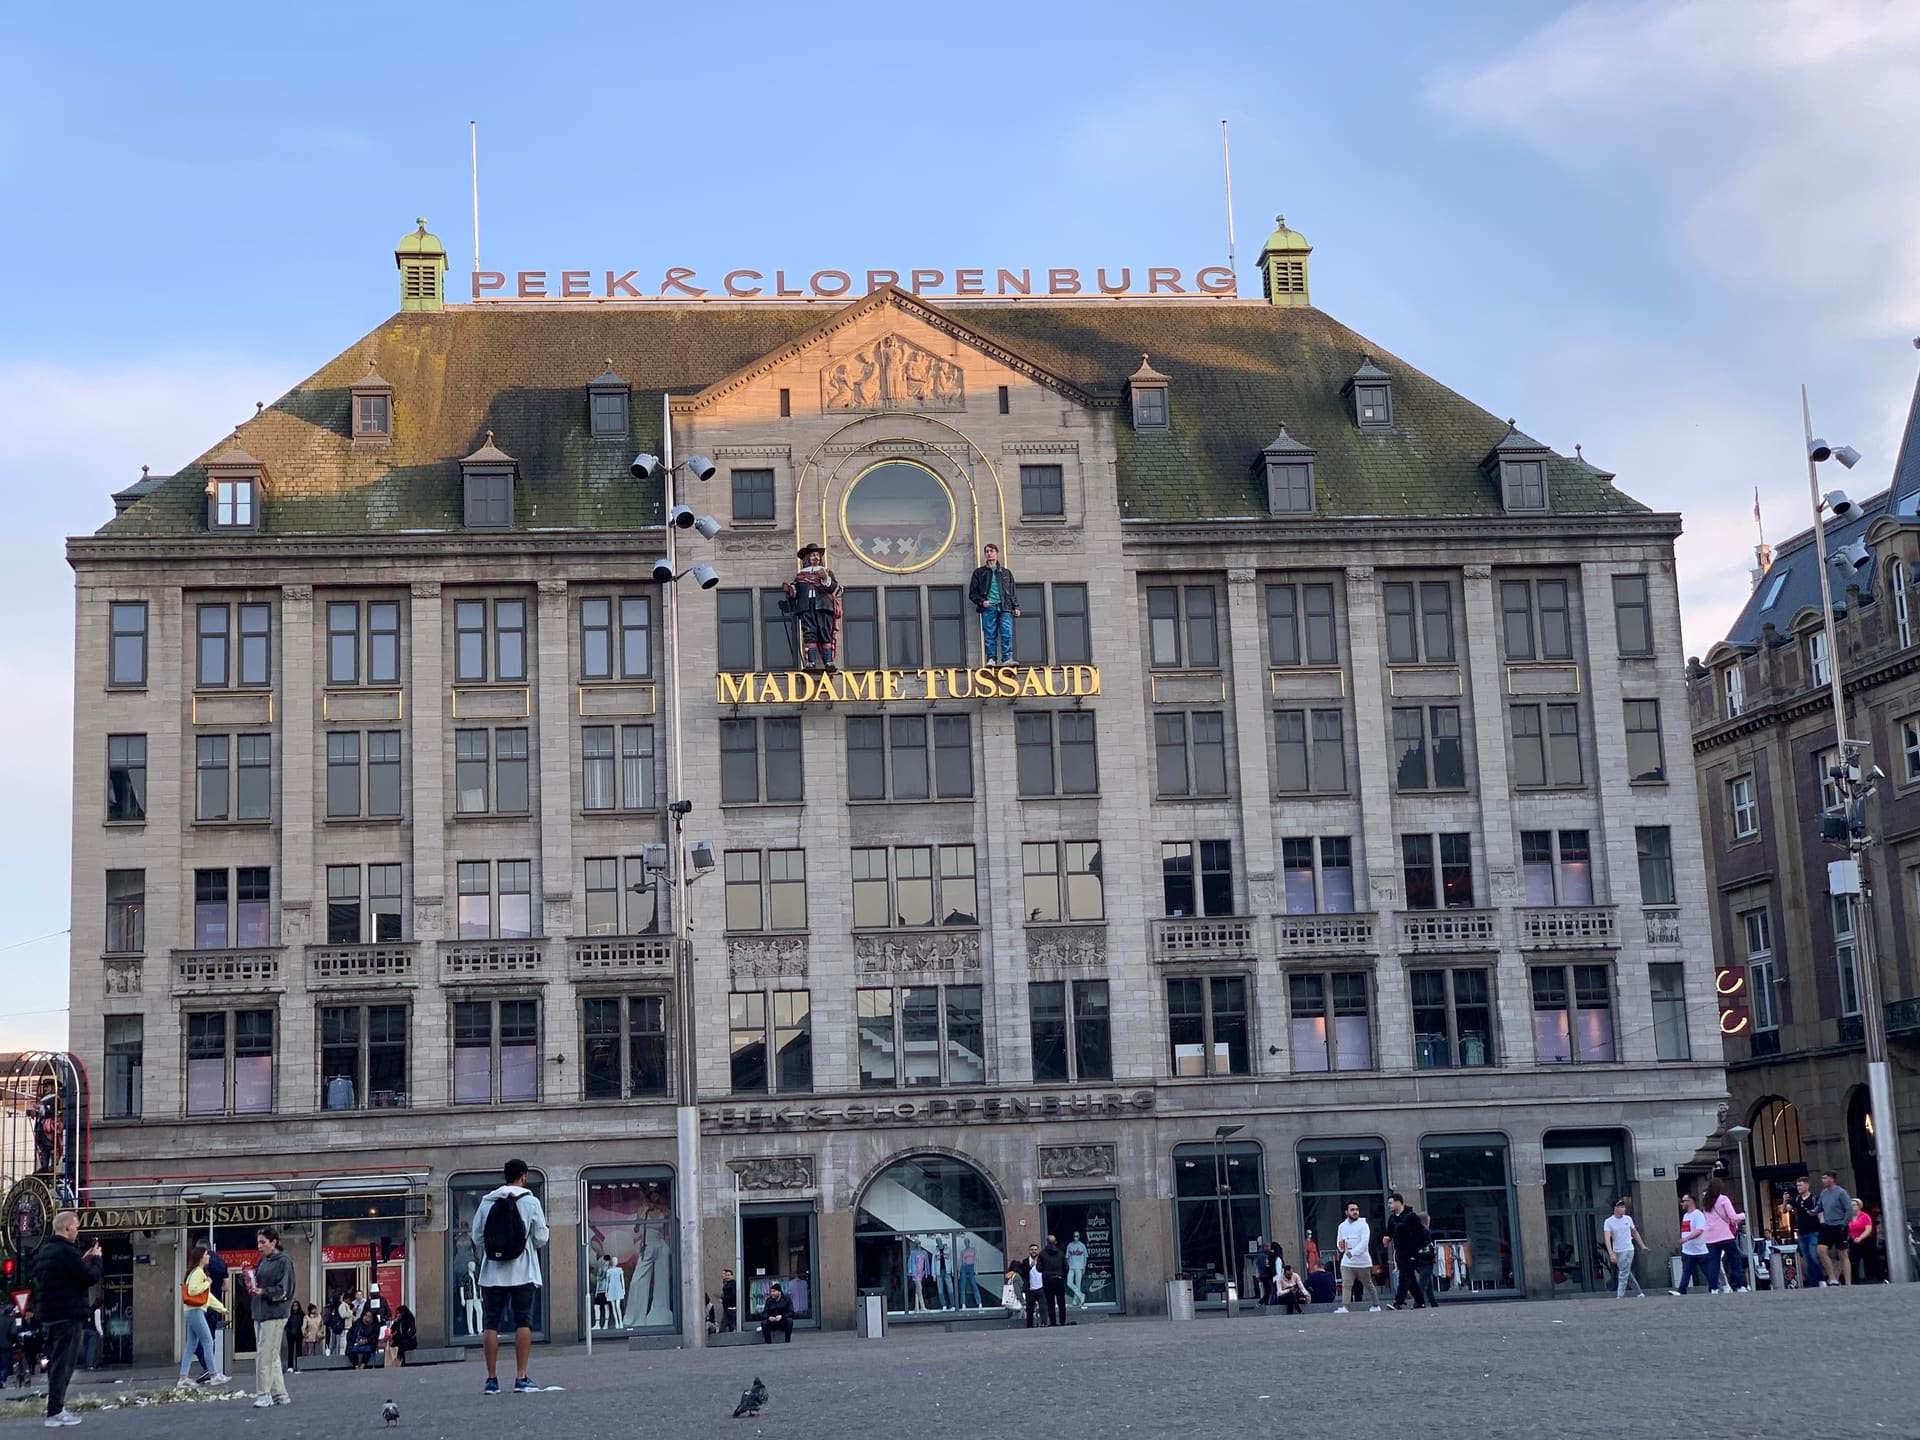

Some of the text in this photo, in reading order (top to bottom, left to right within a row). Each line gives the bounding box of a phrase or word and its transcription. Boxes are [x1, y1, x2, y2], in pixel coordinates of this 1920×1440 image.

[471, 266, 1237, 298] PEEK & CLOPPENBURG
[717, 666, 1100, 703] MADAME TUSSAUD
[804, 1105, 833, 1124] &
[840, 1090, 1157, 1123] CLOPPENBURG
[176, 1204, 273, 1225] TUSSAUD
